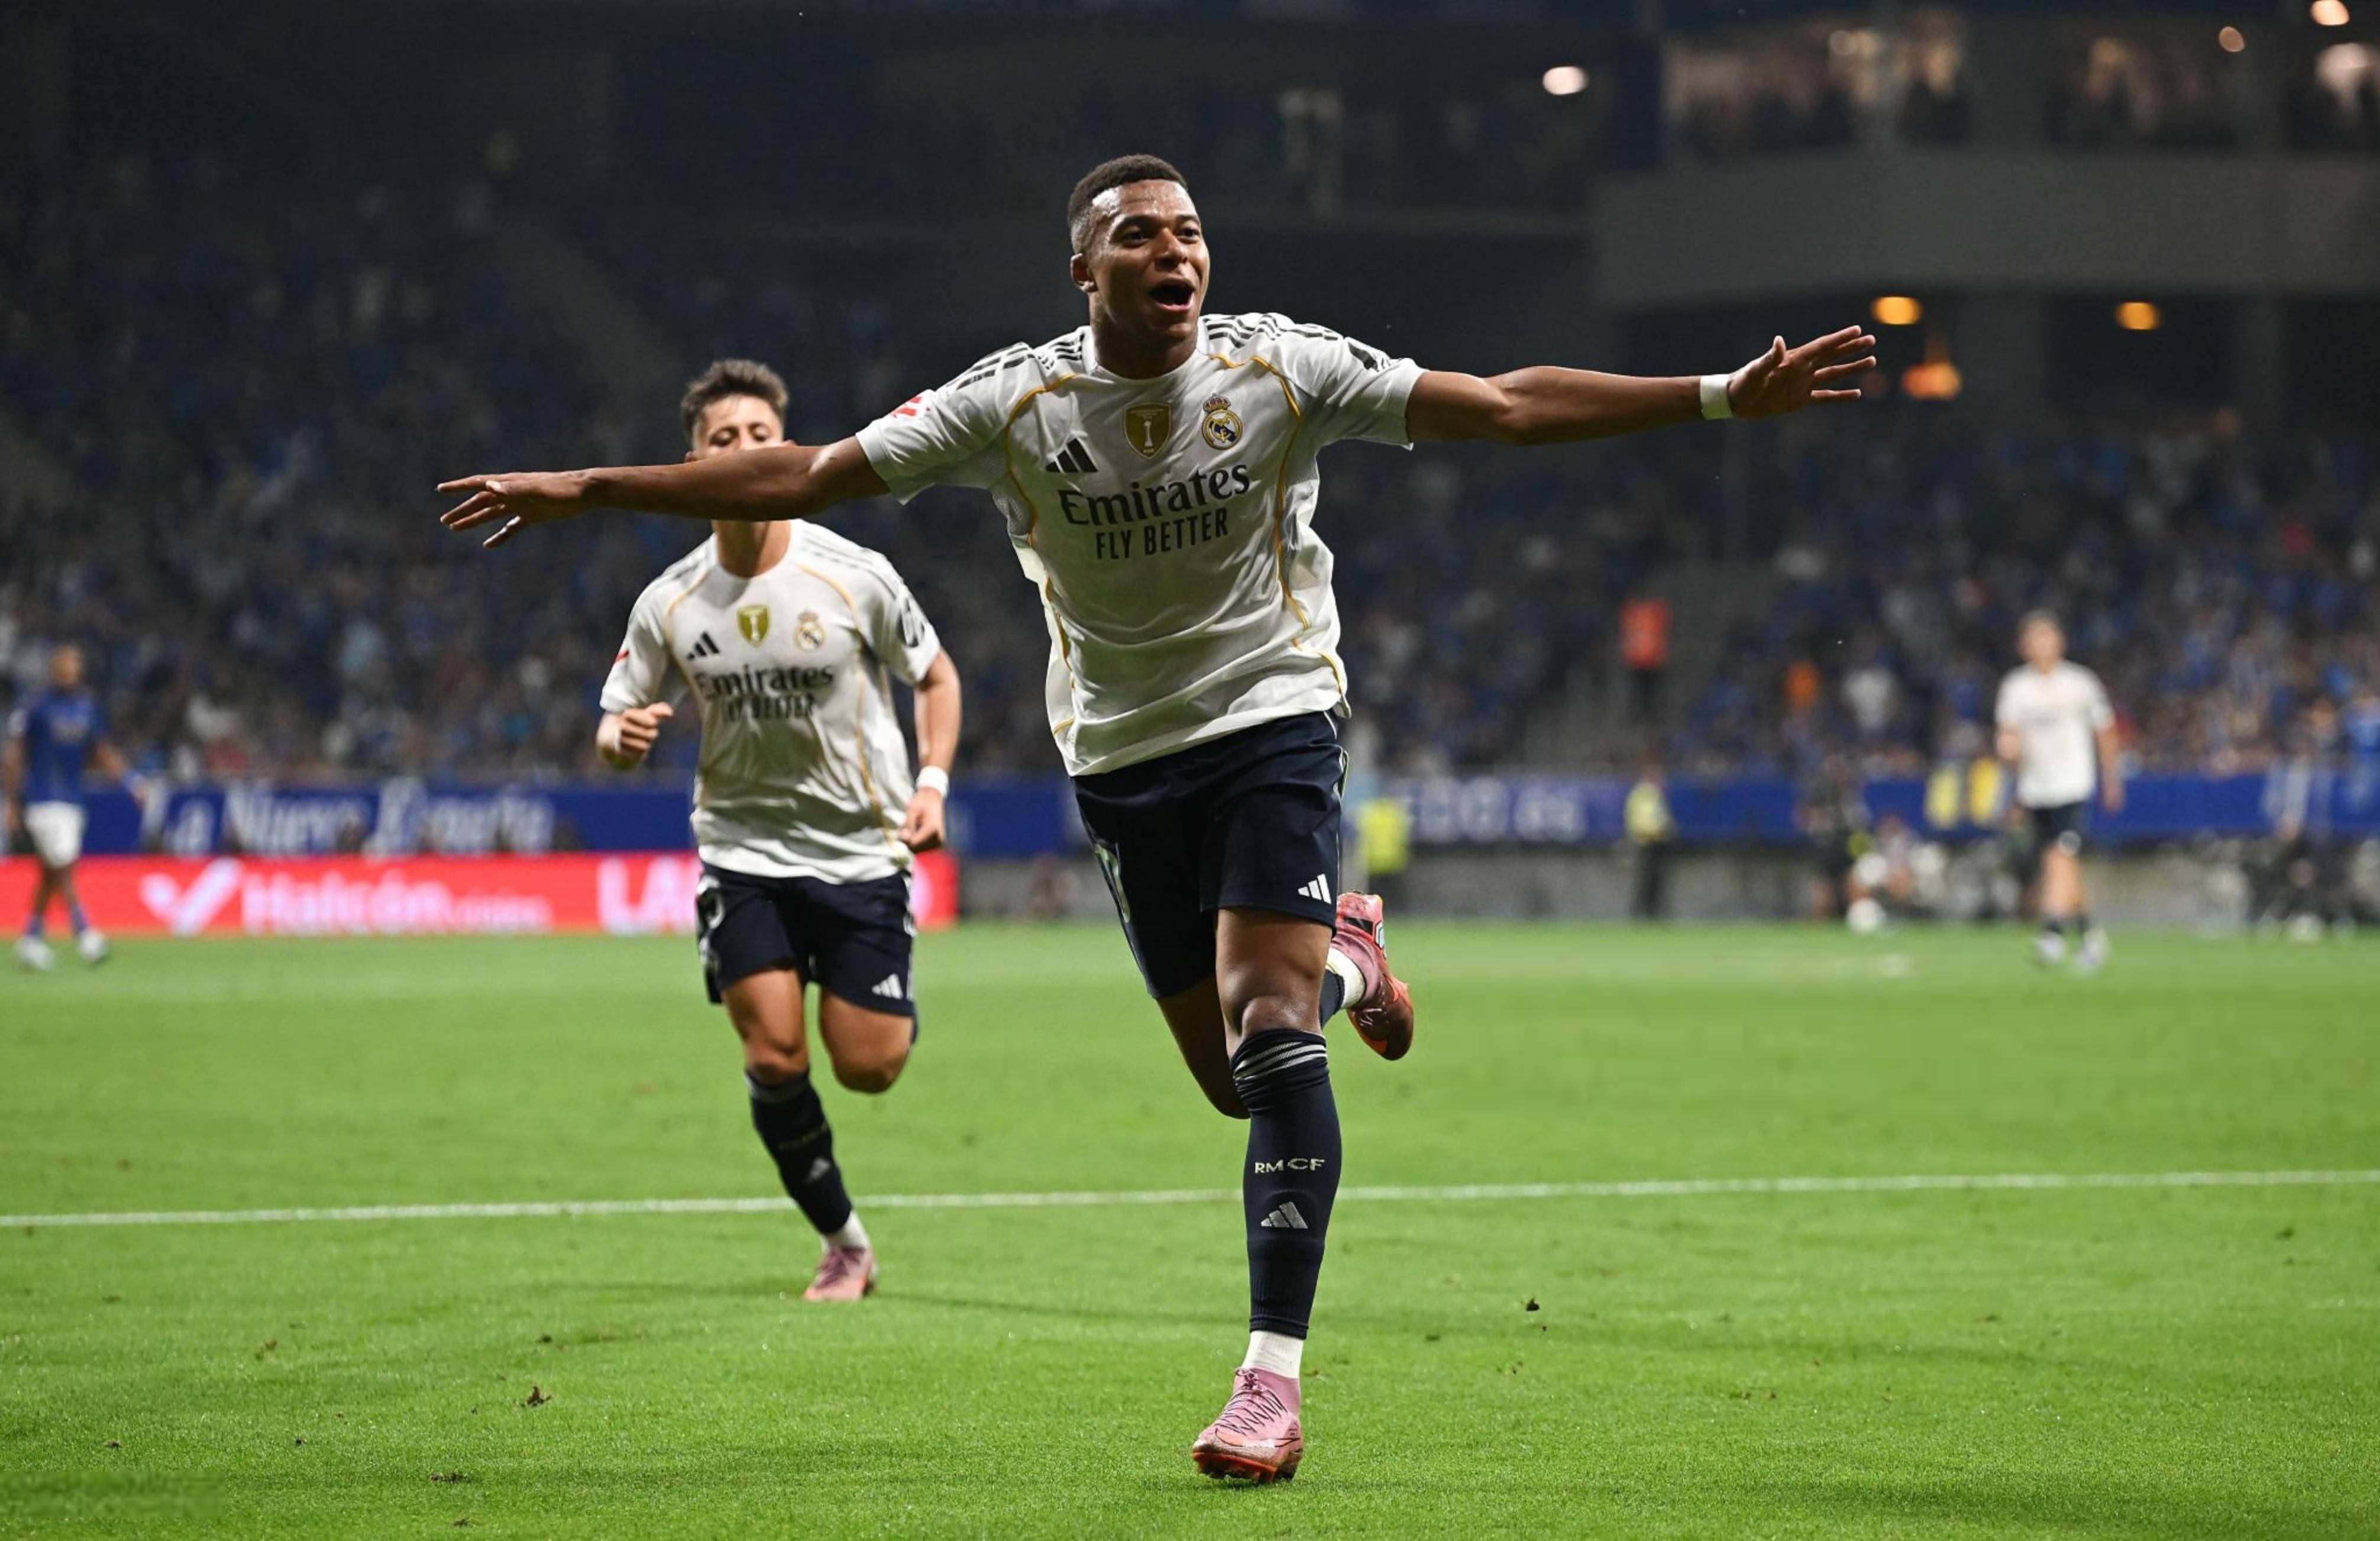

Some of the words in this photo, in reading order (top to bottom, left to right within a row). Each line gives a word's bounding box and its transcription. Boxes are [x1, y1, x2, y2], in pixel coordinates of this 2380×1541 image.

[1058, 464, 1251, 525] Emirates
[1096, 529, 1132, 559] FLY
[1144, 507, 1229, 556] BETTER
[694, 663, 835, 700] Emirates
[1254, 1158, 1325, 1174] RMCF
